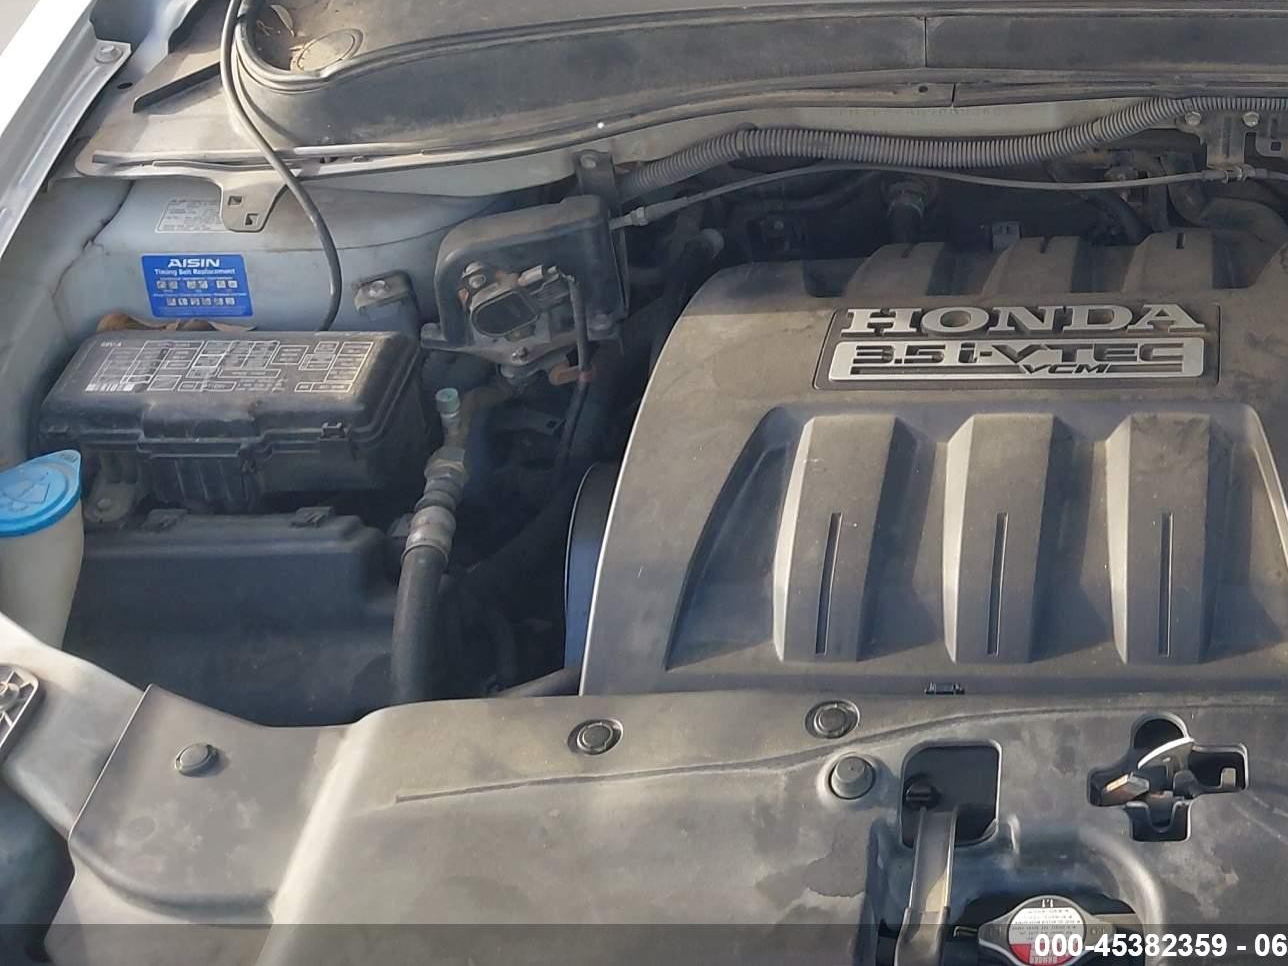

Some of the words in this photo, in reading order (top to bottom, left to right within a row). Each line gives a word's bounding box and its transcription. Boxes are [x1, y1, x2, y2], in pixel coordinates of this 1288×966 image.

[167, 258, 220, 268] AISIN
[840, 303, 1206, 338] HONDA
[1023, 363, 1112, 375] VCM
